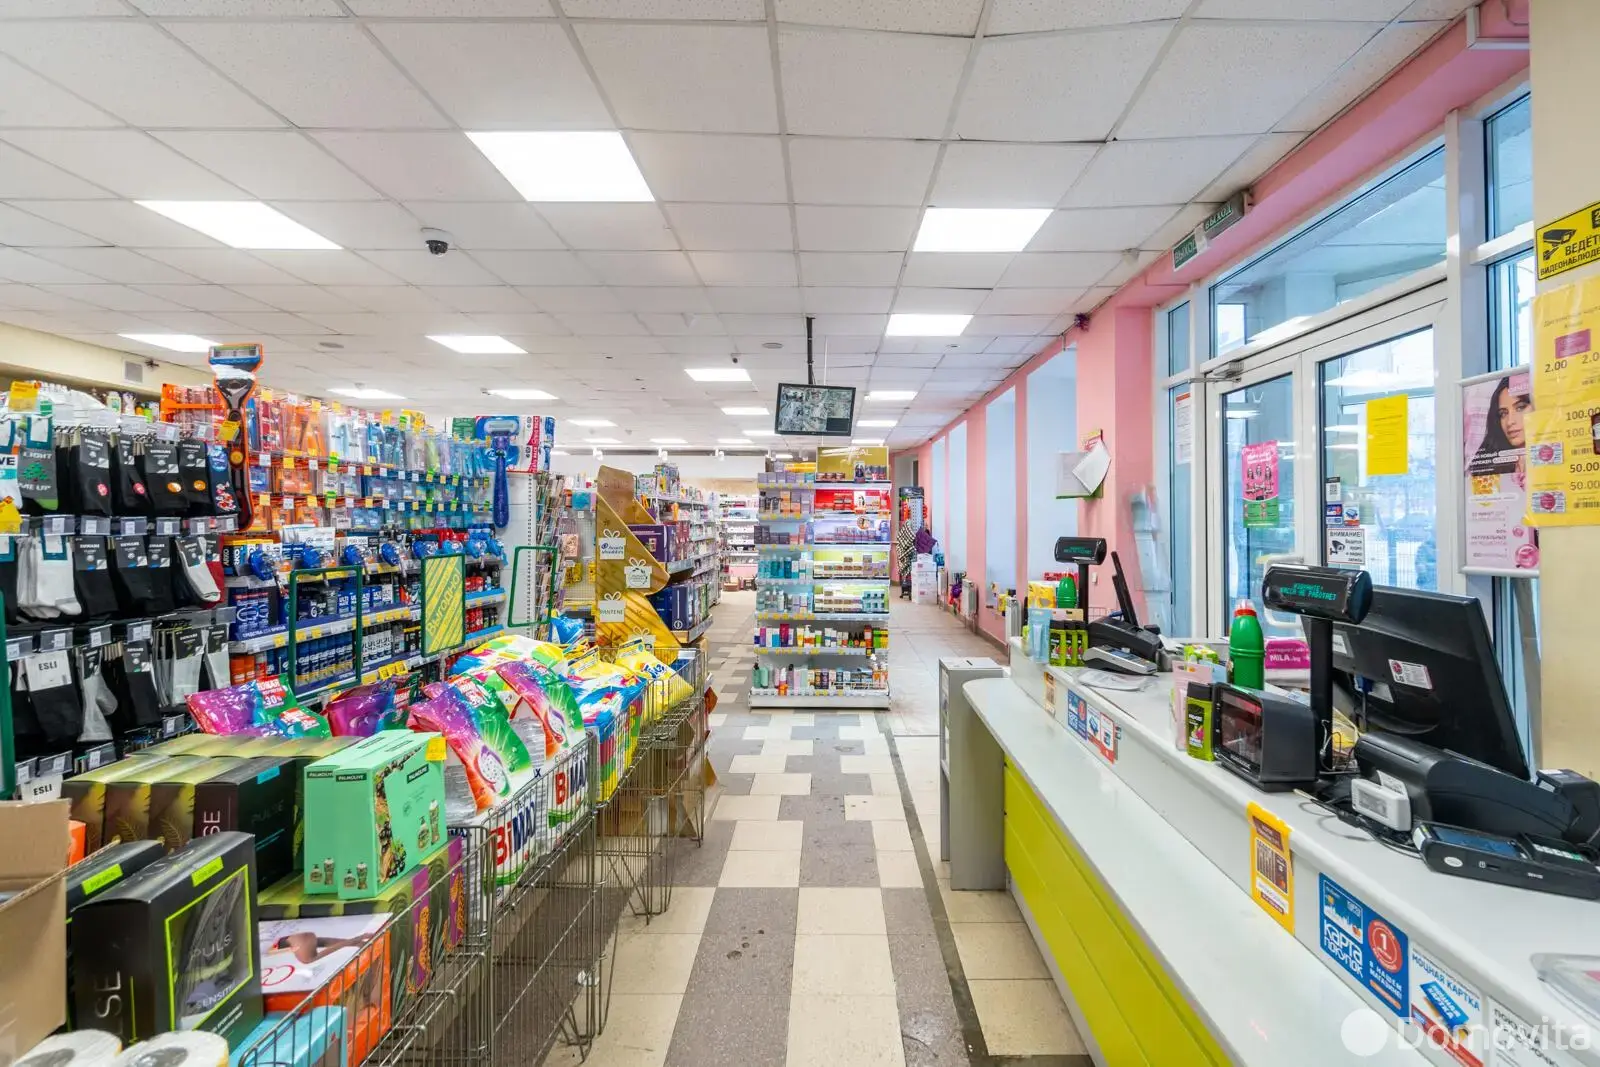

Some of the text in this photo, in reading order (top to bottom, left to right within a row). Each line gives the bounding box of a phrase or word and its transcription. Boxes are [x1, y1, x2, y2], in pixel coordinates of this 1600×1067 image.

[1175, 241, 1197, 263] ВЫХОД
[39, 661, 58, 671] ESLI
[33, 784, 53, 796] ESLI
[1412, 954, 1481, 1012] МОЩНАЯ КАРТКА
